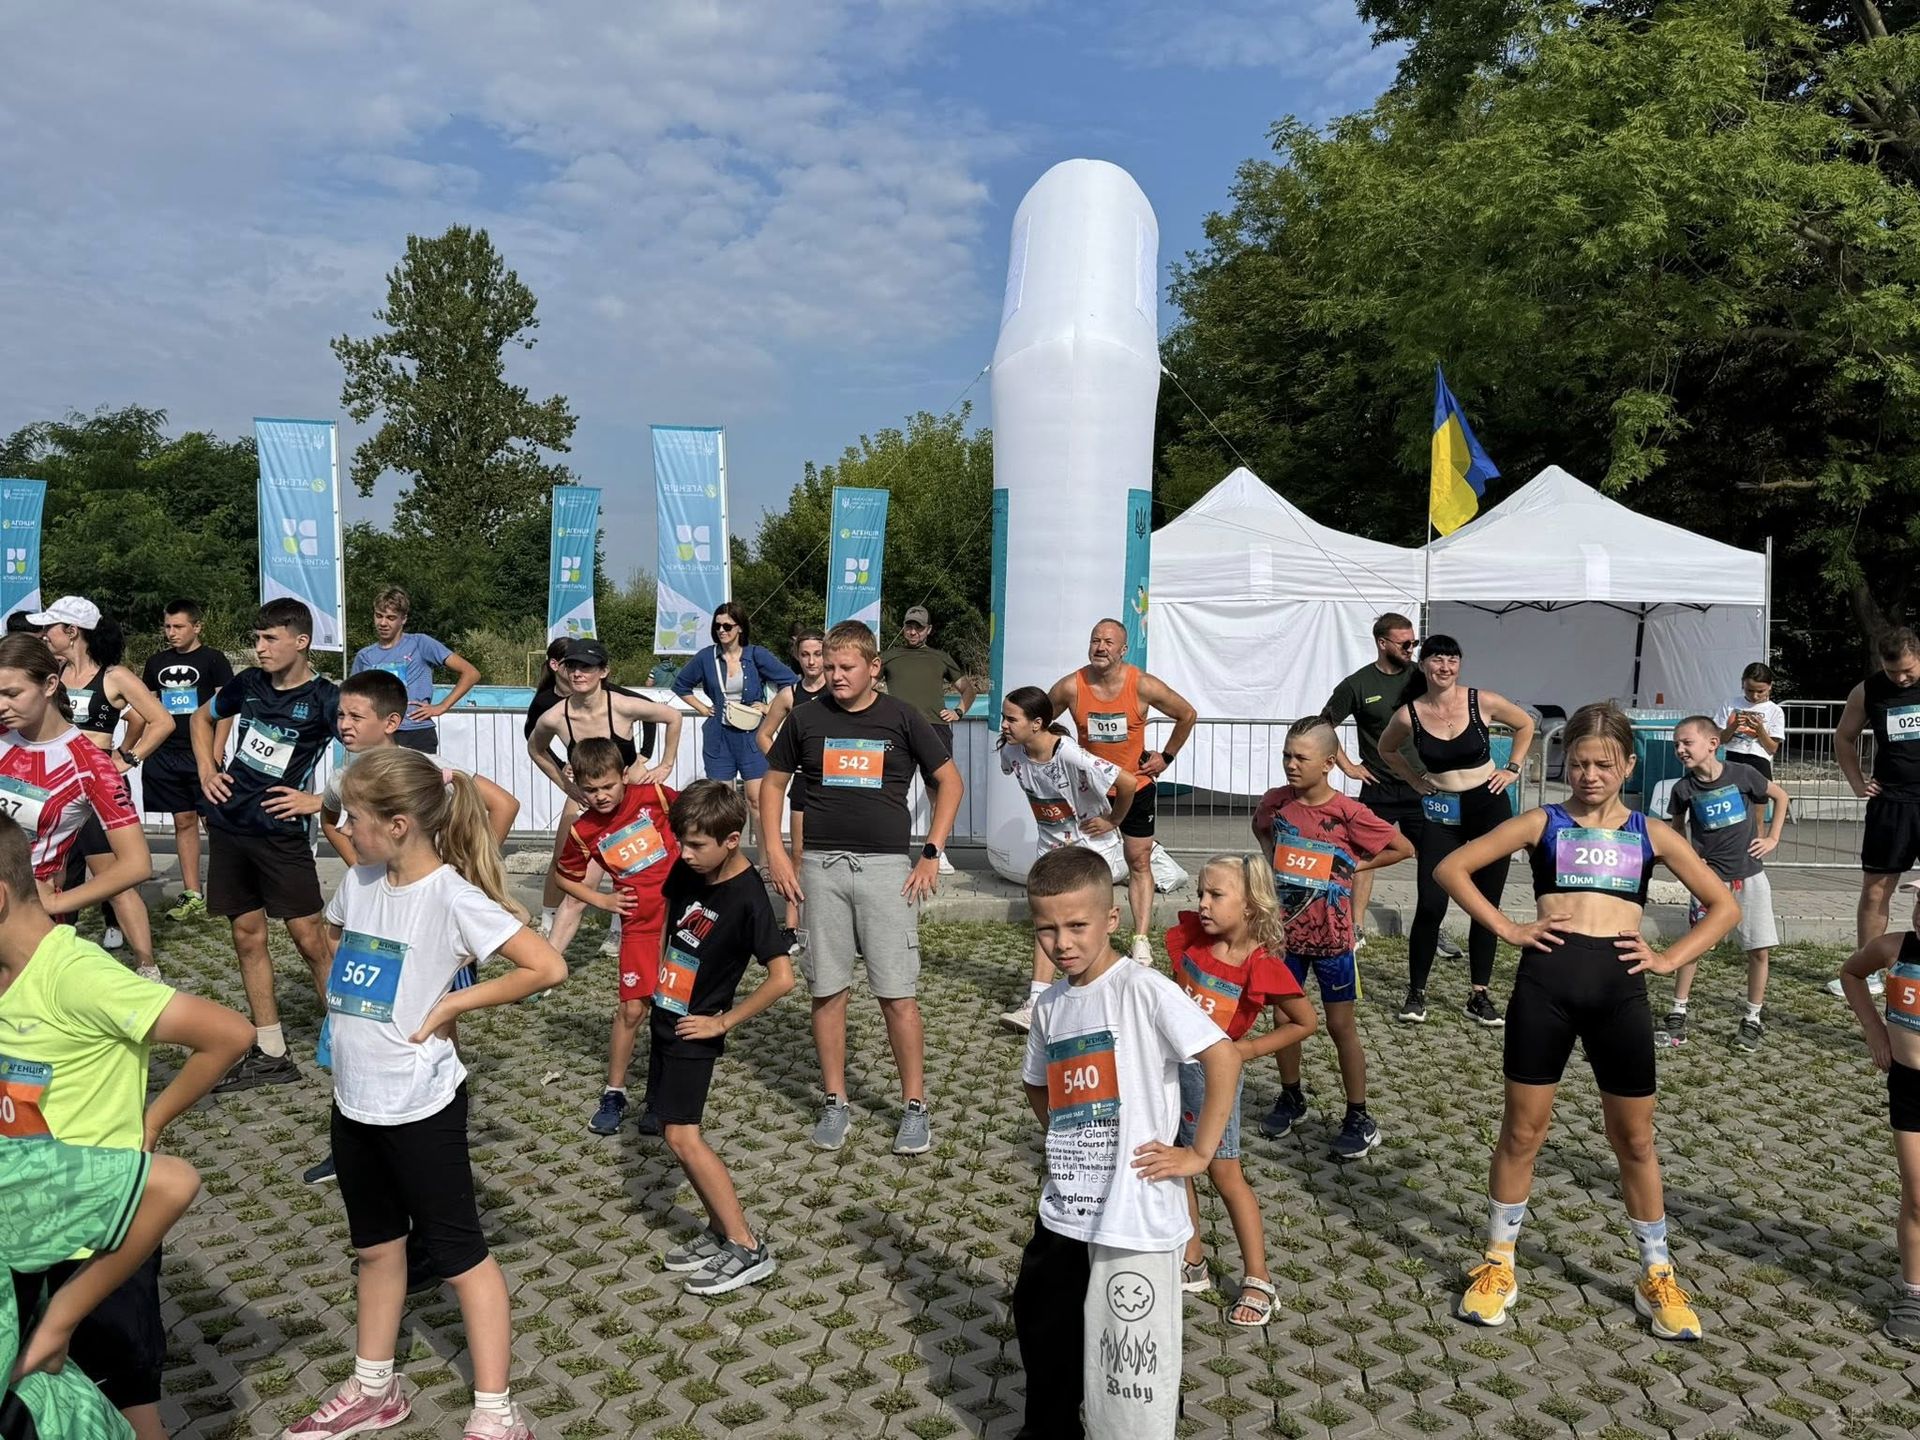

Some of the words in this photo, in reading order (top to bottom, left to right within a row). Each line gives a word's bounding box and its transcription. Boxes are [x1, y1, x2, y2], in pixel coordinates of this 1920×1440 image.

[171, 695, 190, 705] 560
[1097, 722, 1118, 732] 019
[1899, 716, 1920, 729] 029
[250, 738, 274, 757] 420
[839, 755, 870, 770] 542
[1428, 800, 1449, 814] 580
[1705, 800, 1732, 817] 579
[618, 837, 648, 861] 513
[1574, 847, 1618, 867] 208
[1286, 853, 1318, 871] 547
[341, 960, 381, 988] 567
[1902, 986, 1917, 1005] 5
[8, 1063, 44, 1075] АГЕНЦІЯ
[1064, 1064, 1100, 1095] 540
[0, 1095, 15, 1124] 0
[1084, 1129, 1110, 1138] Glam
[1077, 1140, 1105, 1148] Course
[1106, 1373, 1154, 1405] Baby
